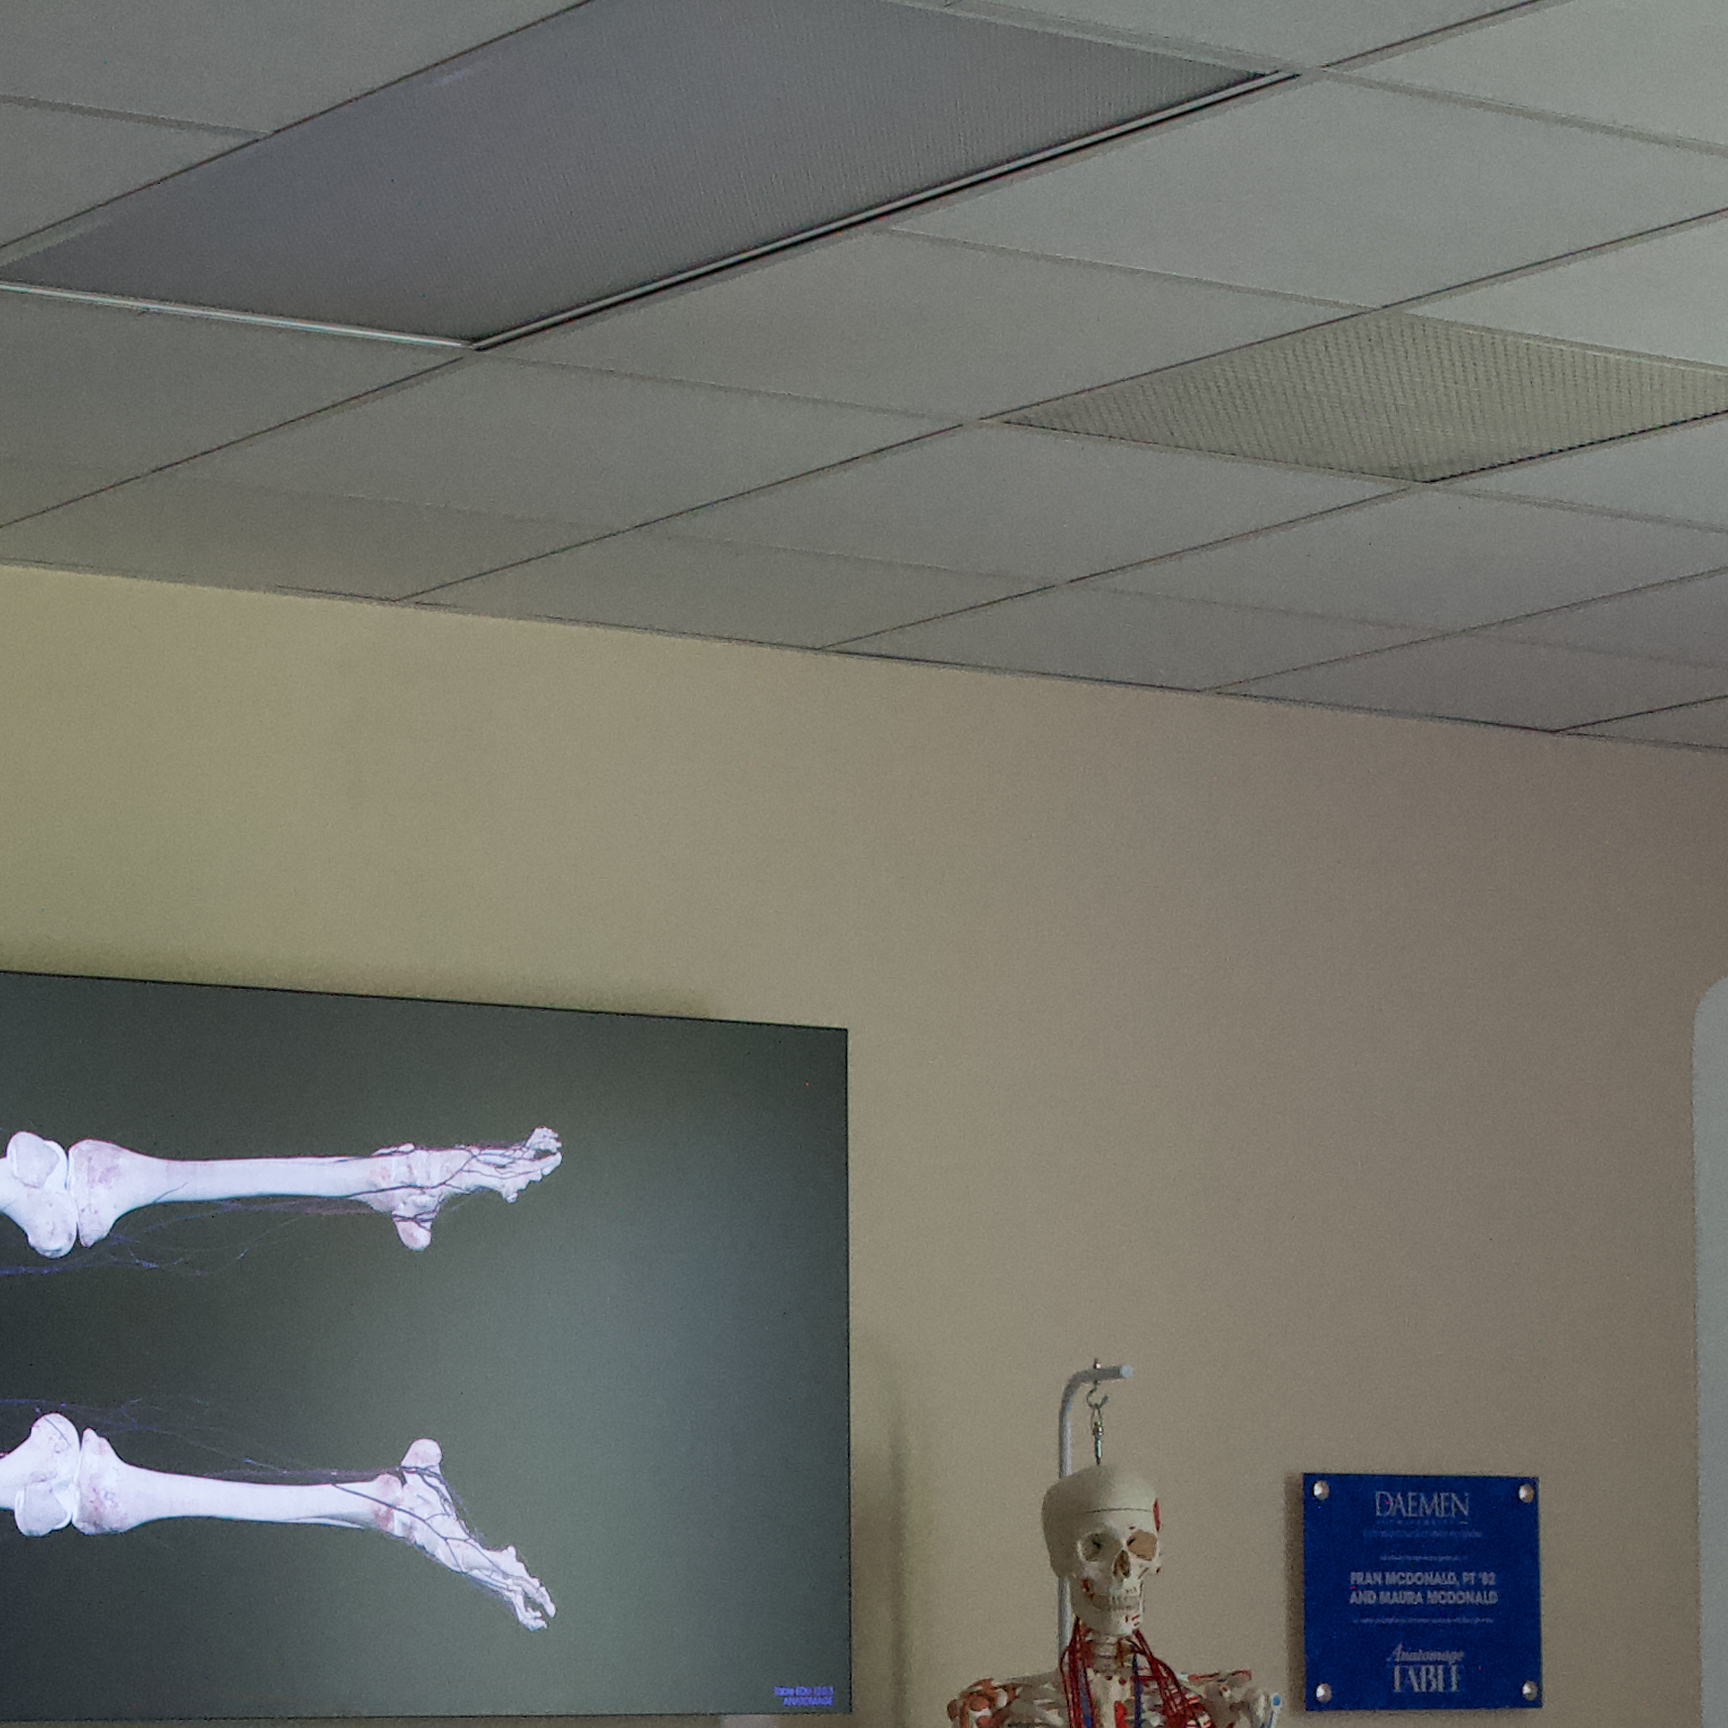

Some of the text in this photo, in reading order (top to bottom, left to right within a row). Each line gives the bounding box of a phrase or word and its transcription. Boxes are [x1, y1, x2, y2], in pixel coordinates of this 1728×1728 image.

[1375, 1491, 1469, 1518] DAEMEN
[1350, 1571, 1383, 1585] FRAN
[1462, 1571, 1477, 1585] PT
[1350, 1590, 1377, 1604] AND
[1426, 1590, 1498, 1604] MCDONALD
